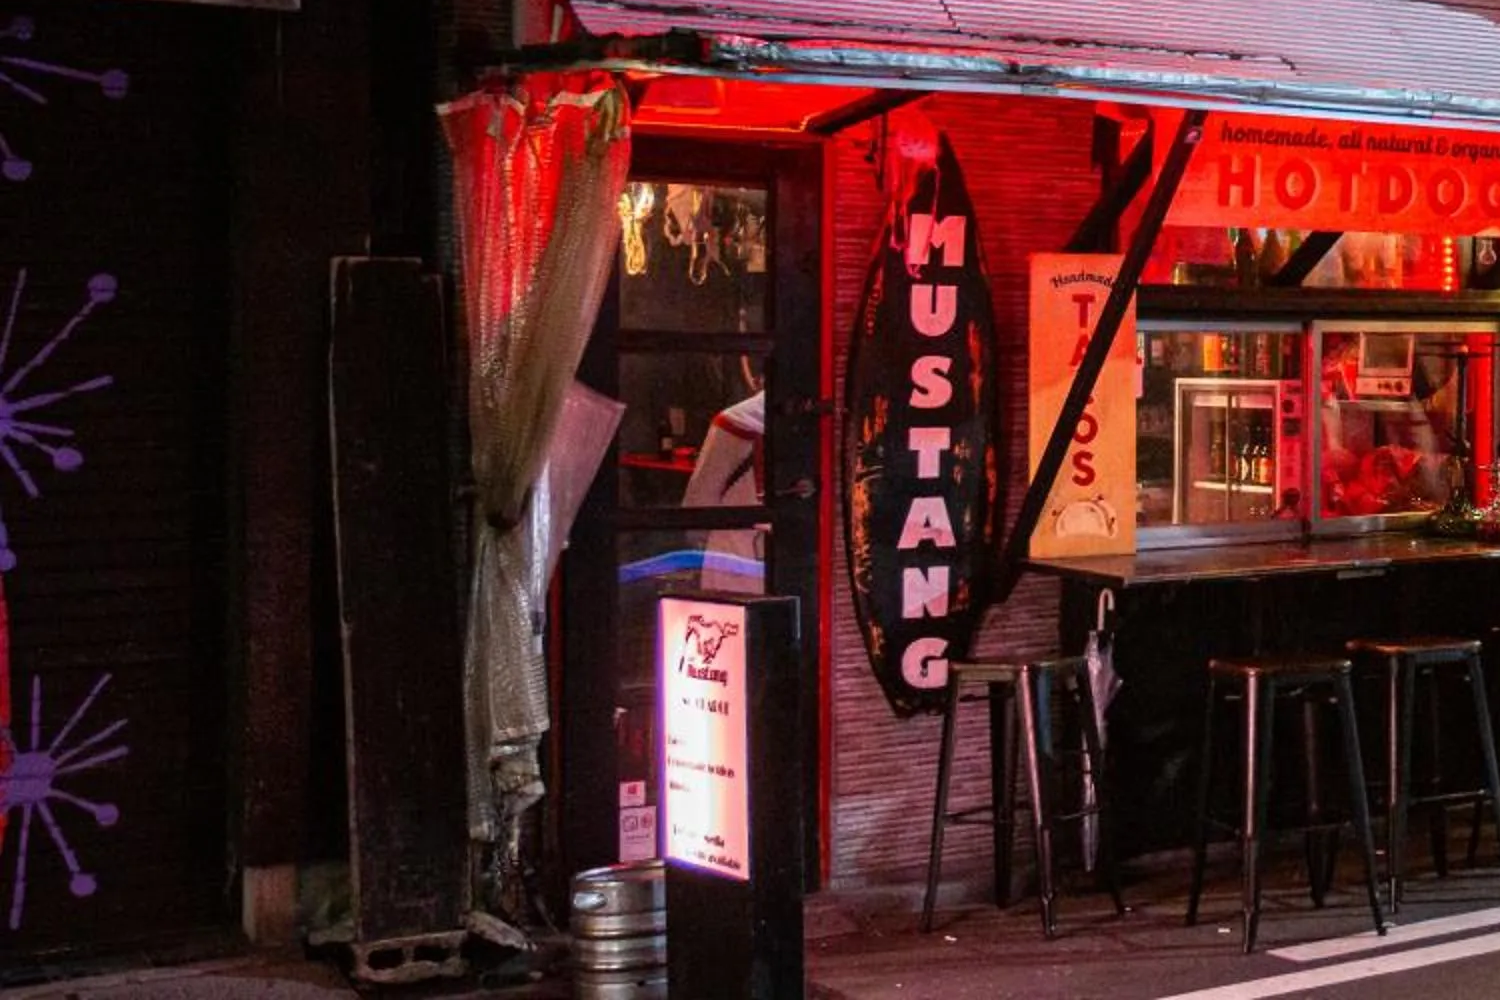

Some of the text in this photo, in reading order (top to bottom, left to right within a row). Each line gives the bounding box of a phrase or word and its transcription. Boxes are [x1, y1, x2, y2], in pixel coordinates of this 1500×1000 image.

[1221, 121, 1334, 150] homemade,
[1338, 129, 1362, 150] all
[1366, 134, 1434, 156] natural
[1436, 135, 1449, 156] &
[1050, 269, 1114, 288] Handmad
[1069, 293, 1099, 487] TAOS
[898, 213, 967, 690] MUSTANG
